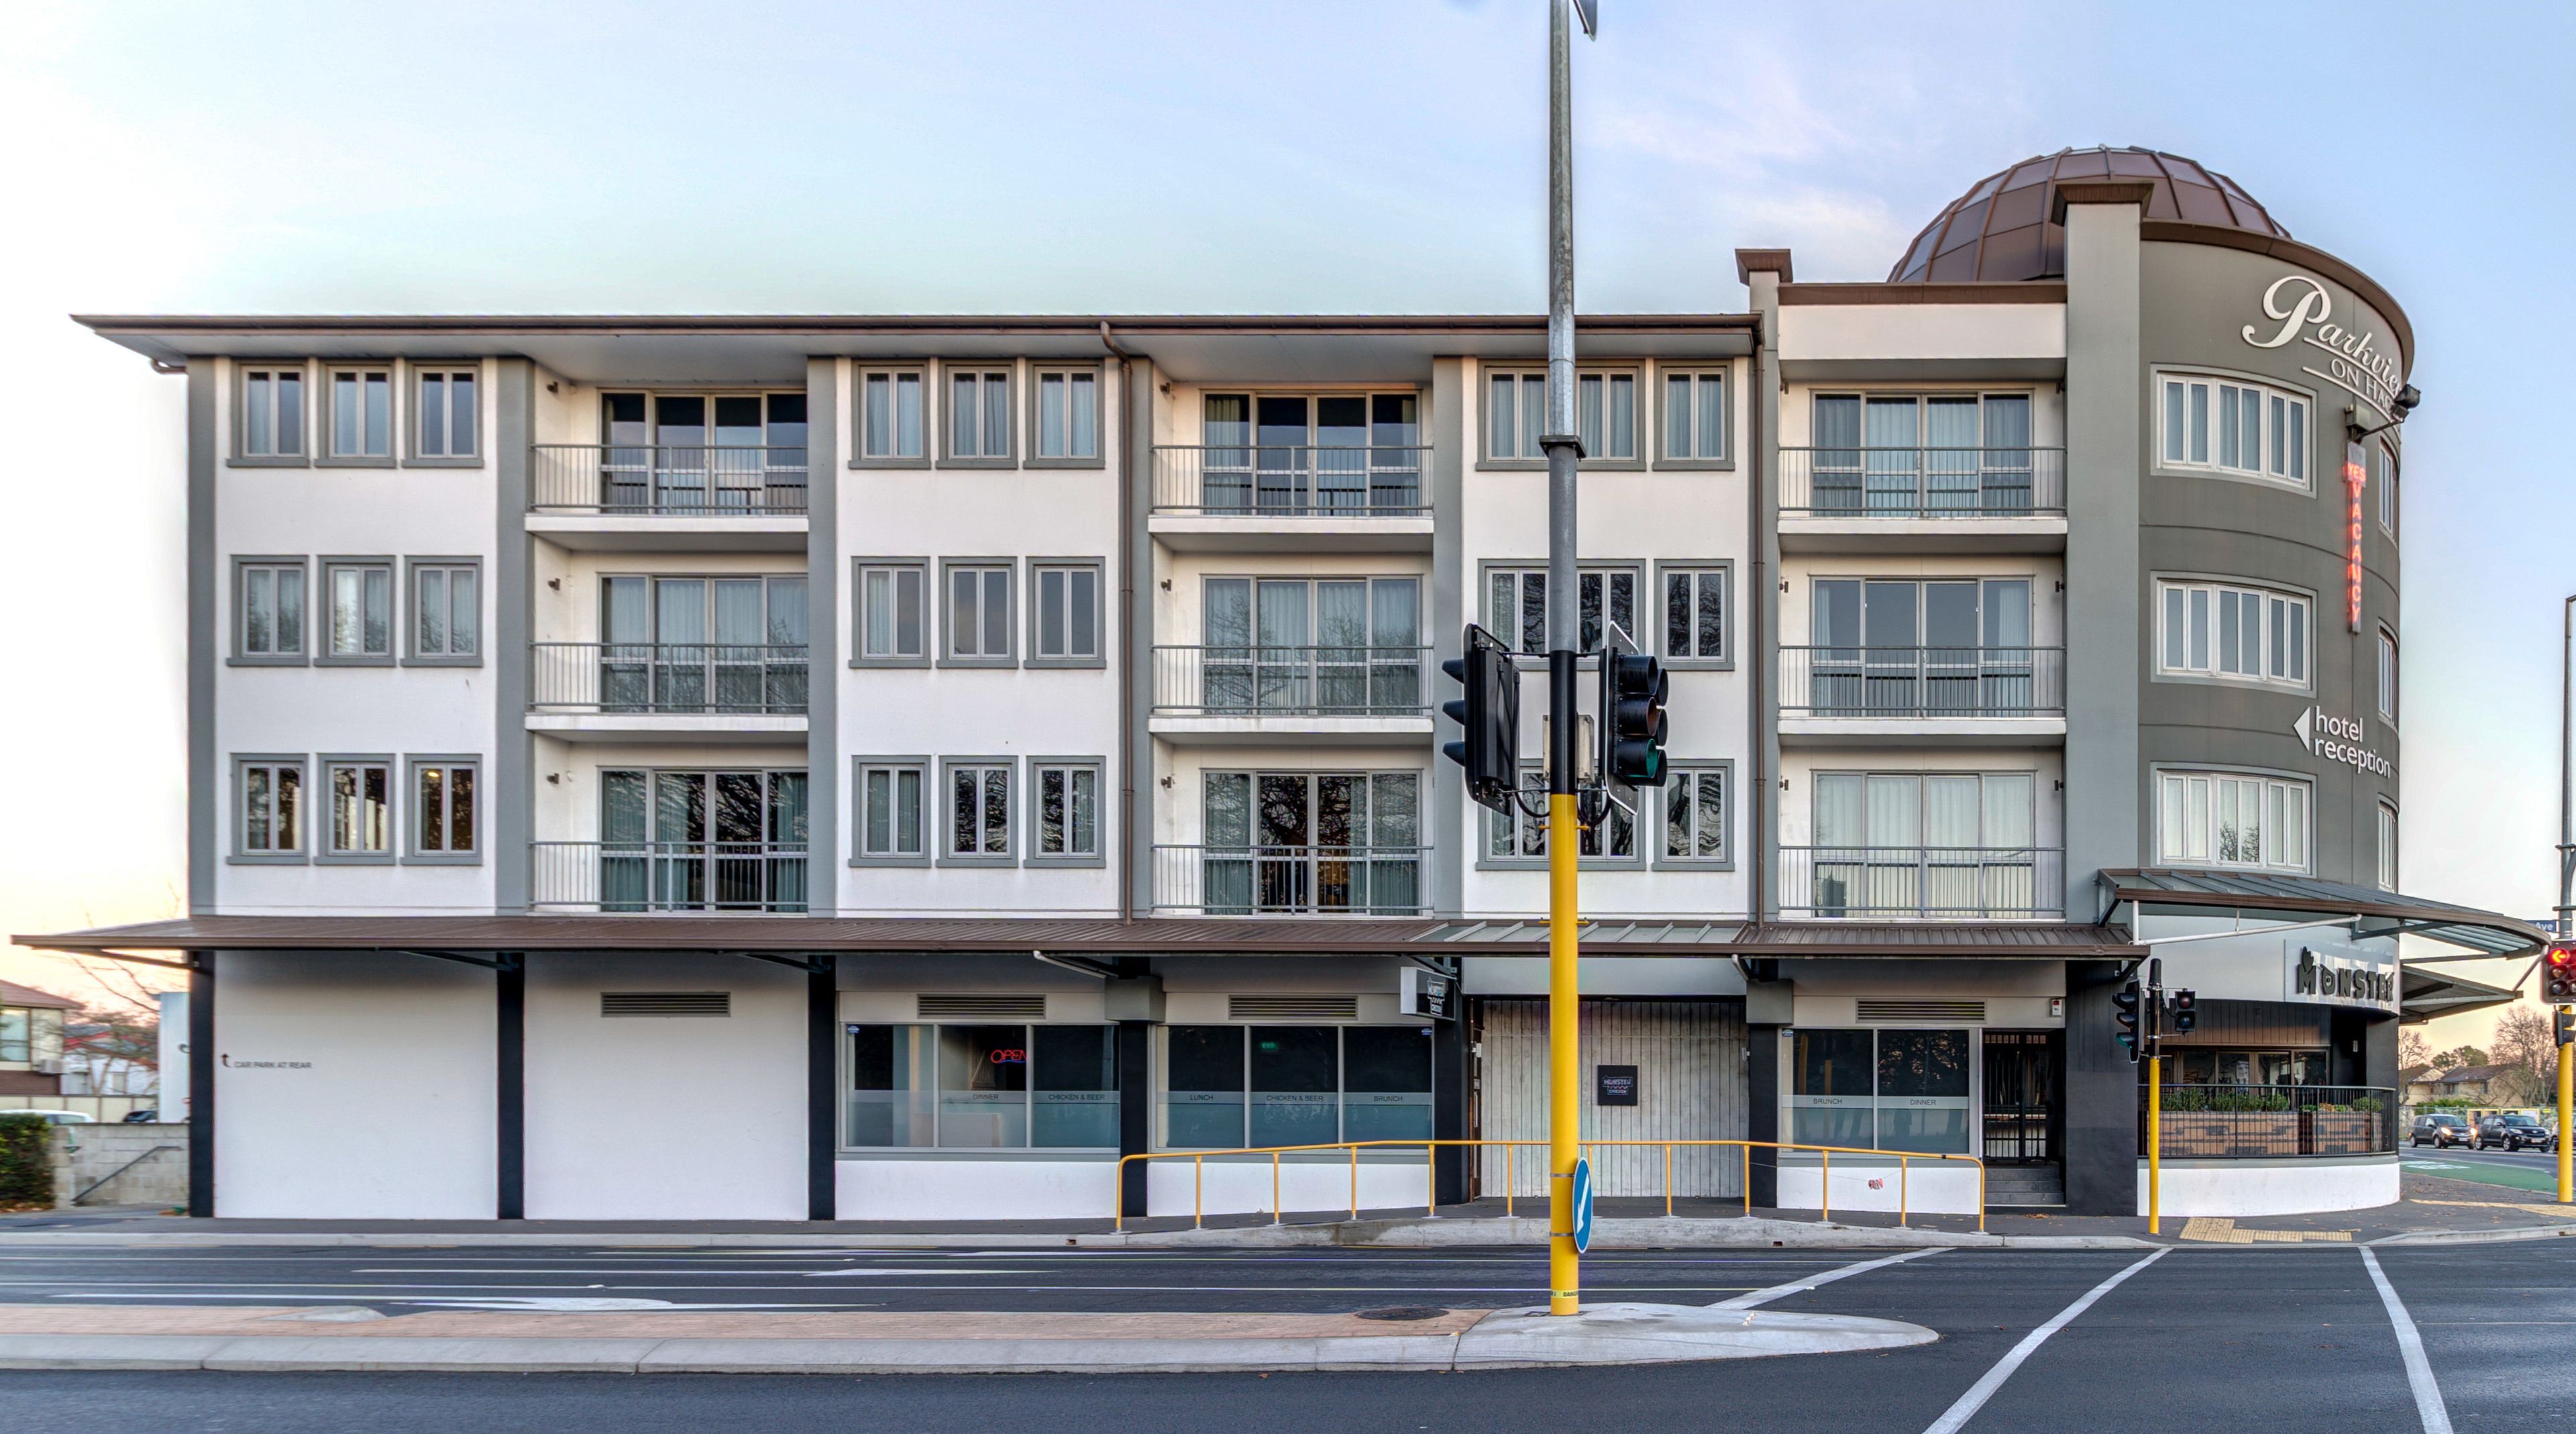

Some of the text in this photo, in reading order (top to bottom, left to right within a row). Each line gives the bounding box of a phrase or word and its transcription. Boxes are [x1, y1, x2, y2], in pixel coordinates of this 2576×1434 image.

[2330, 358, 2359, 387] ON
[2347, 462, 2366, 482] YES
[2351, 482, 2362, 623] VACANCY
[2316, 705, 2363, 742] hotel
[2315, 737, 2390, 778] reception
[2536, 922, 2553, 931] Ave
[2297, 956, 2394, 1001] MONSTER
[991, 1049, 1026, 1063] OPEN
